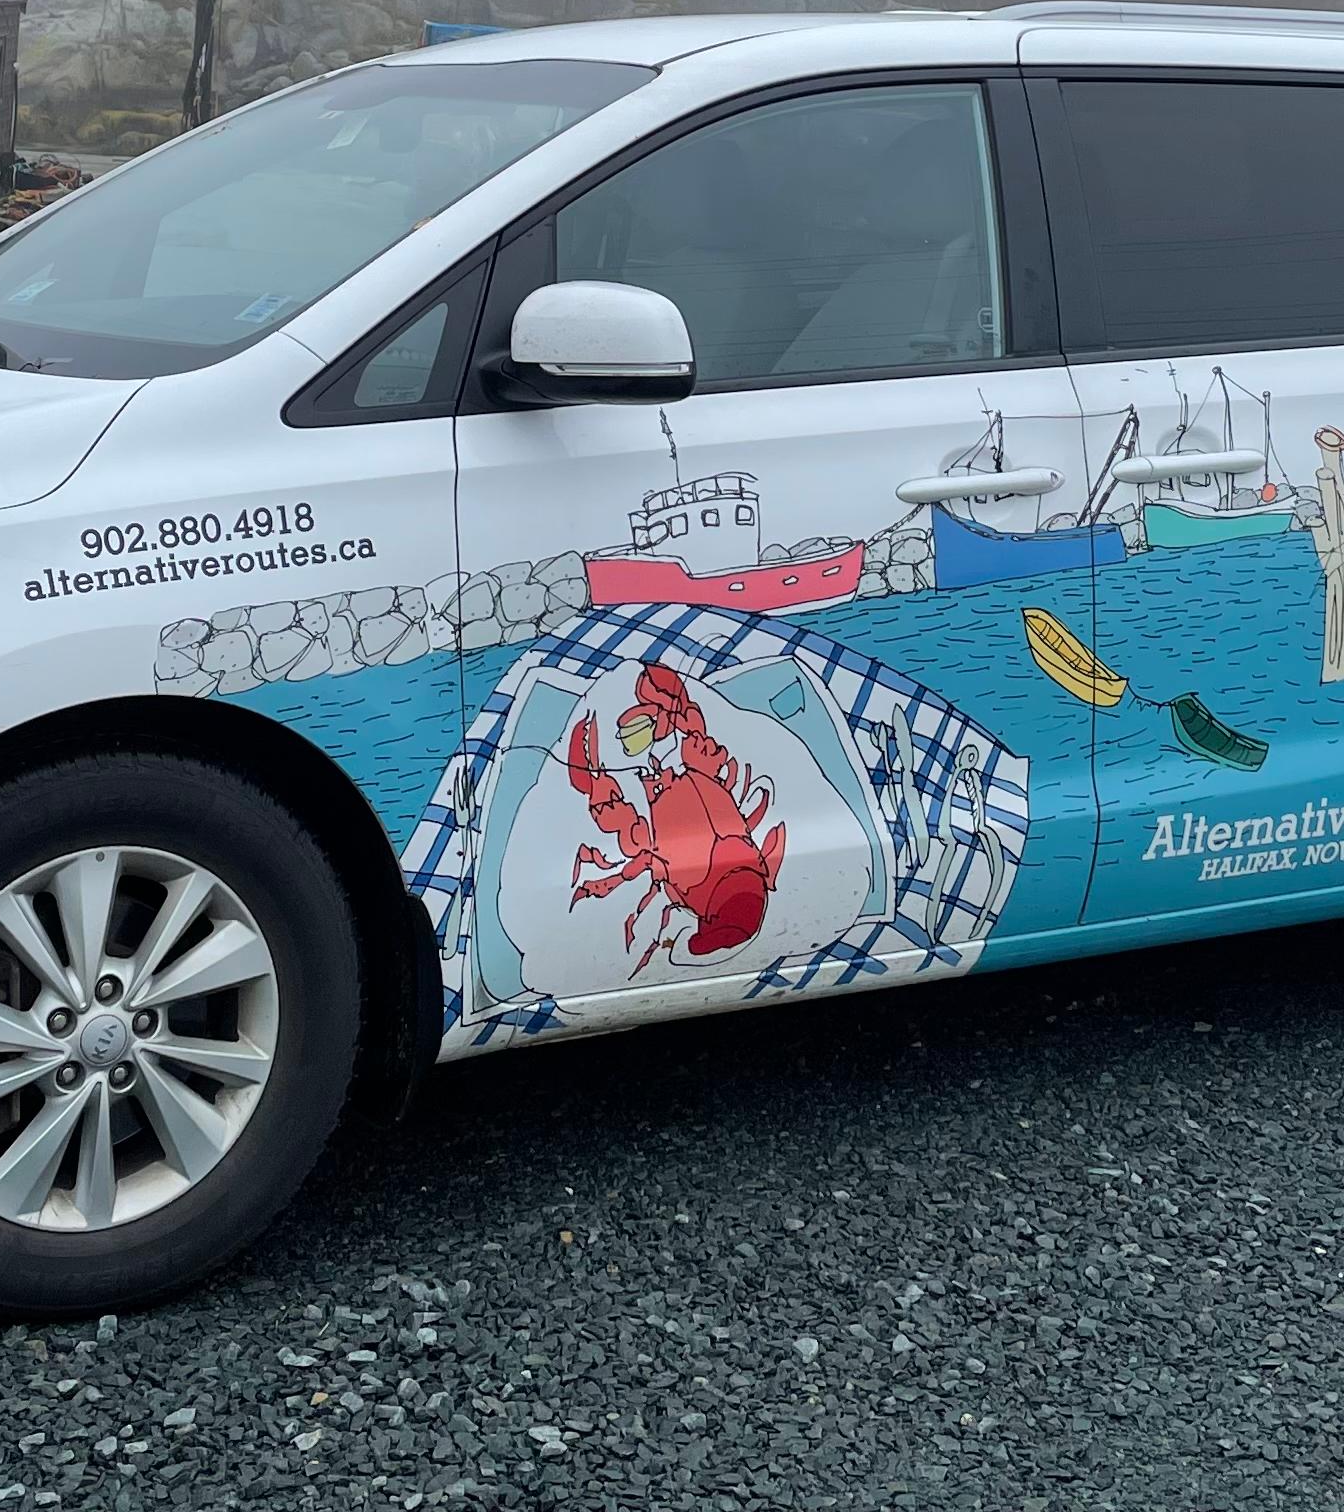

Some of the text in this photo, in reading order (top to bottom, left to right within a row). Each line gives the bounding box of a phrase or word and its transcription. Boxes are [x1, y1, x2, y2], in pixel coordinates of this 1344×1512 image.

[80, 502, 315, 558] 902.880.4918
[24, 536, 377, 602] alternativeroutes.ca
[1197, 846, 1298, 882] HALIFAX,
[91, 1024, 118, 1060] KIA
